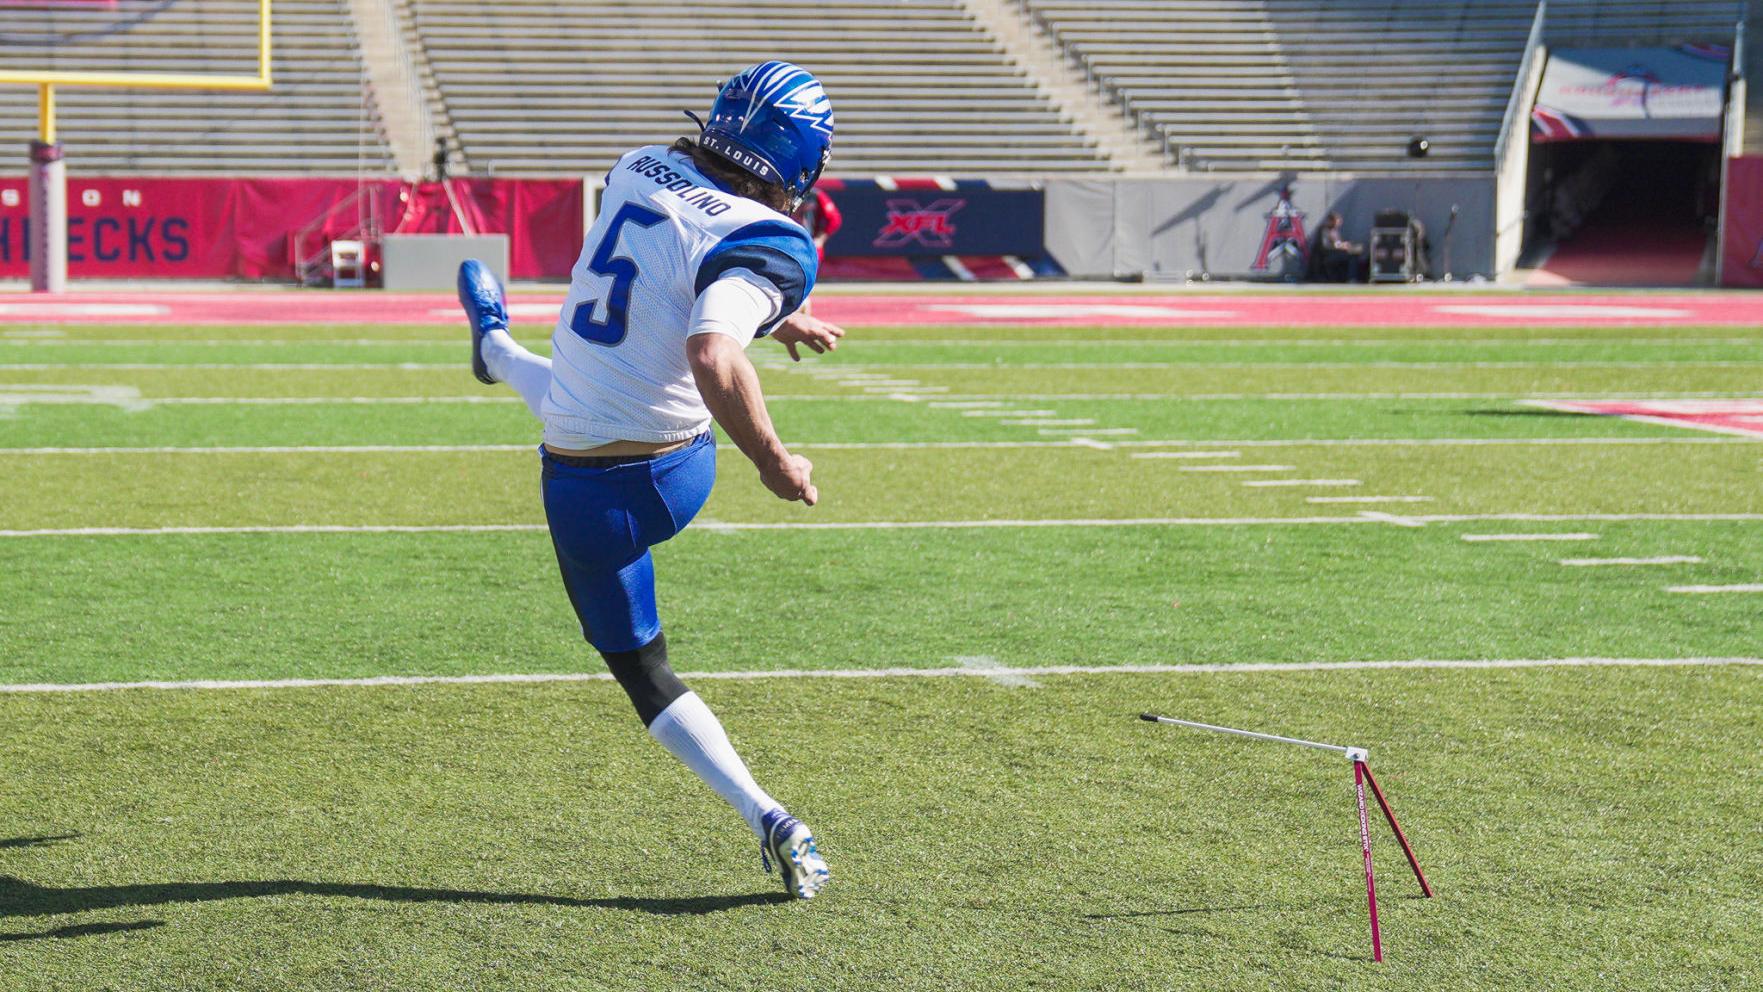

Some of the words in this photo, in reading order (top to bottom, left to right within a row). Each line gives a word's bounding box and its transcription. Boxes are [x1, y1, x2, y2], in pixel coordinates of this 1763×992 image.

[703, 136, 719, 150] ST.
[724, 145, 769, 176] LOUIS
[1, 188, 142, 207] SON
[626, 155, 732, 217] RUSSOLINO
[0, 217, 190, 262] ECKS
[570, 200, 671, 348] 5
